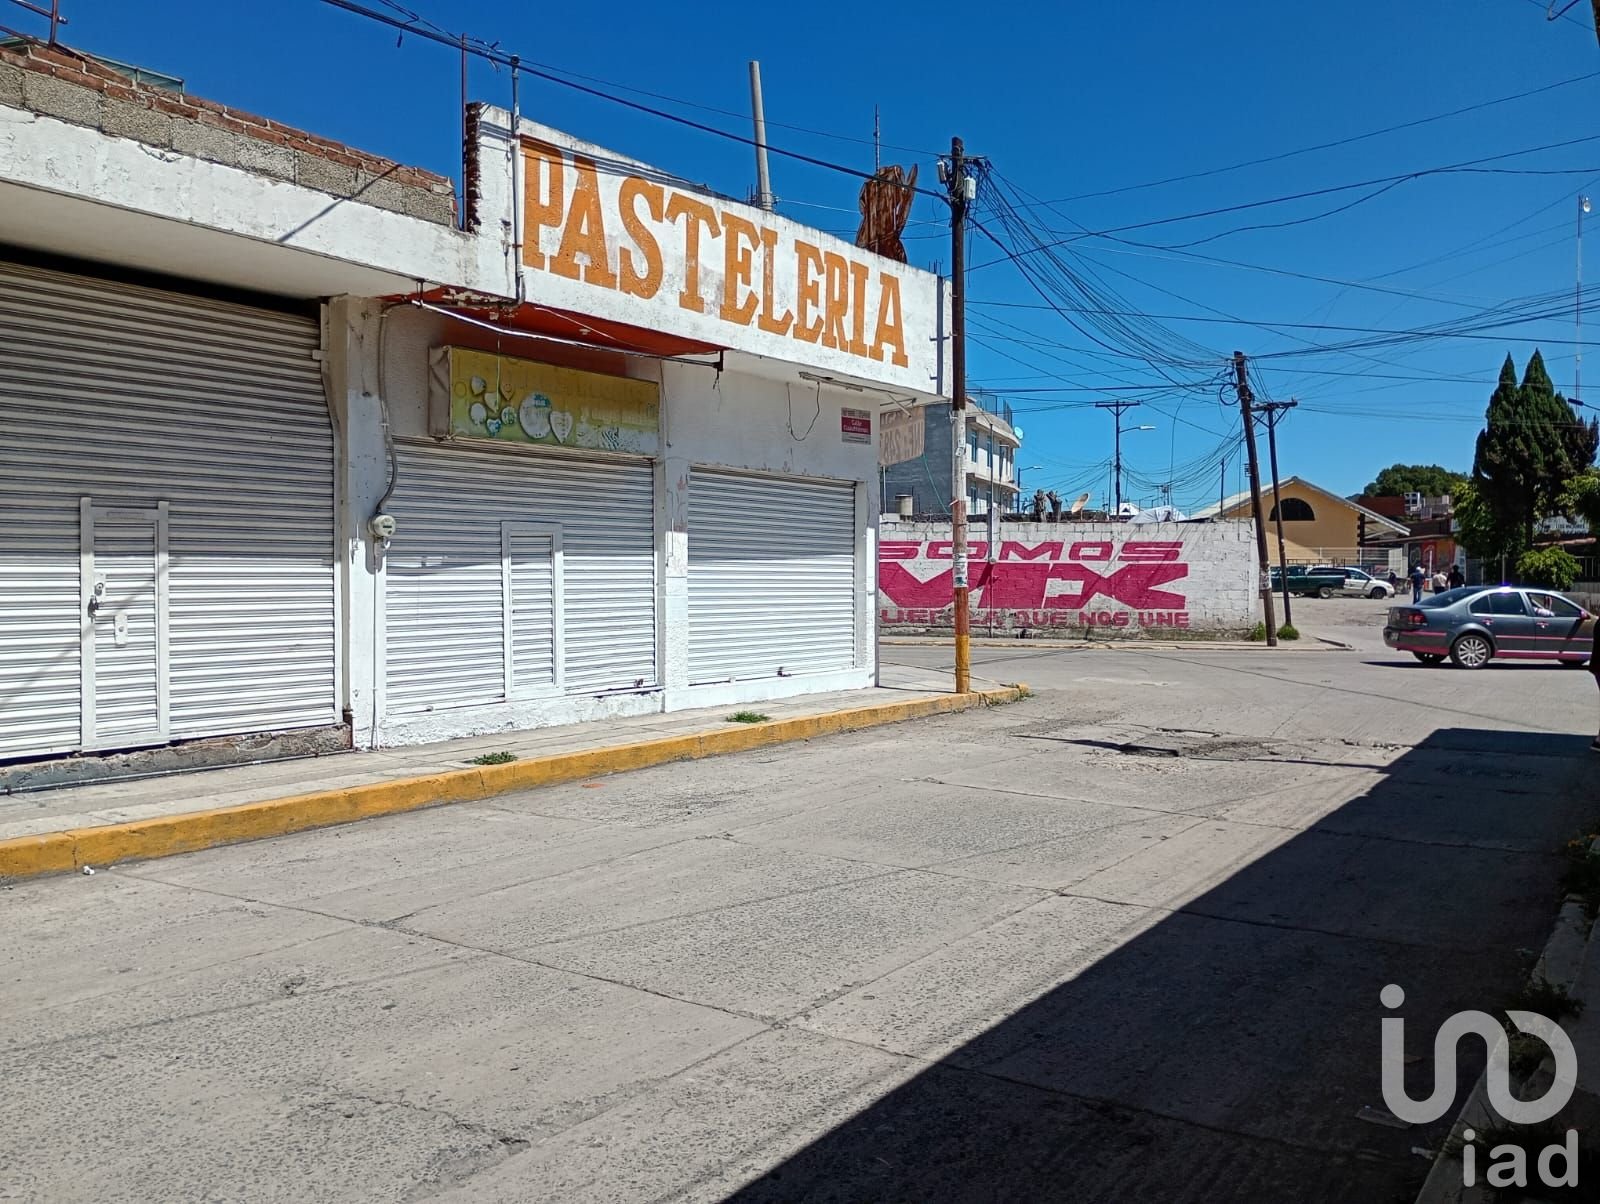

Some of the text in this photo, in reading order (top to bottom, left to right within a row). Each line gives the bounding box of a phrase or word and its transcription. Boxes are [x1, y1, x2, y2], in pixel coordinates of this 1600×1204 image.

[520, 134, 909, 369] PASTELERIA
[879, 541, 1184, 561] SOMOS
[1015, 611, 1067, 627] QUE
[1079, 611, 1129, 627] NOS
[1138, 612, 1190, 628] UNE
